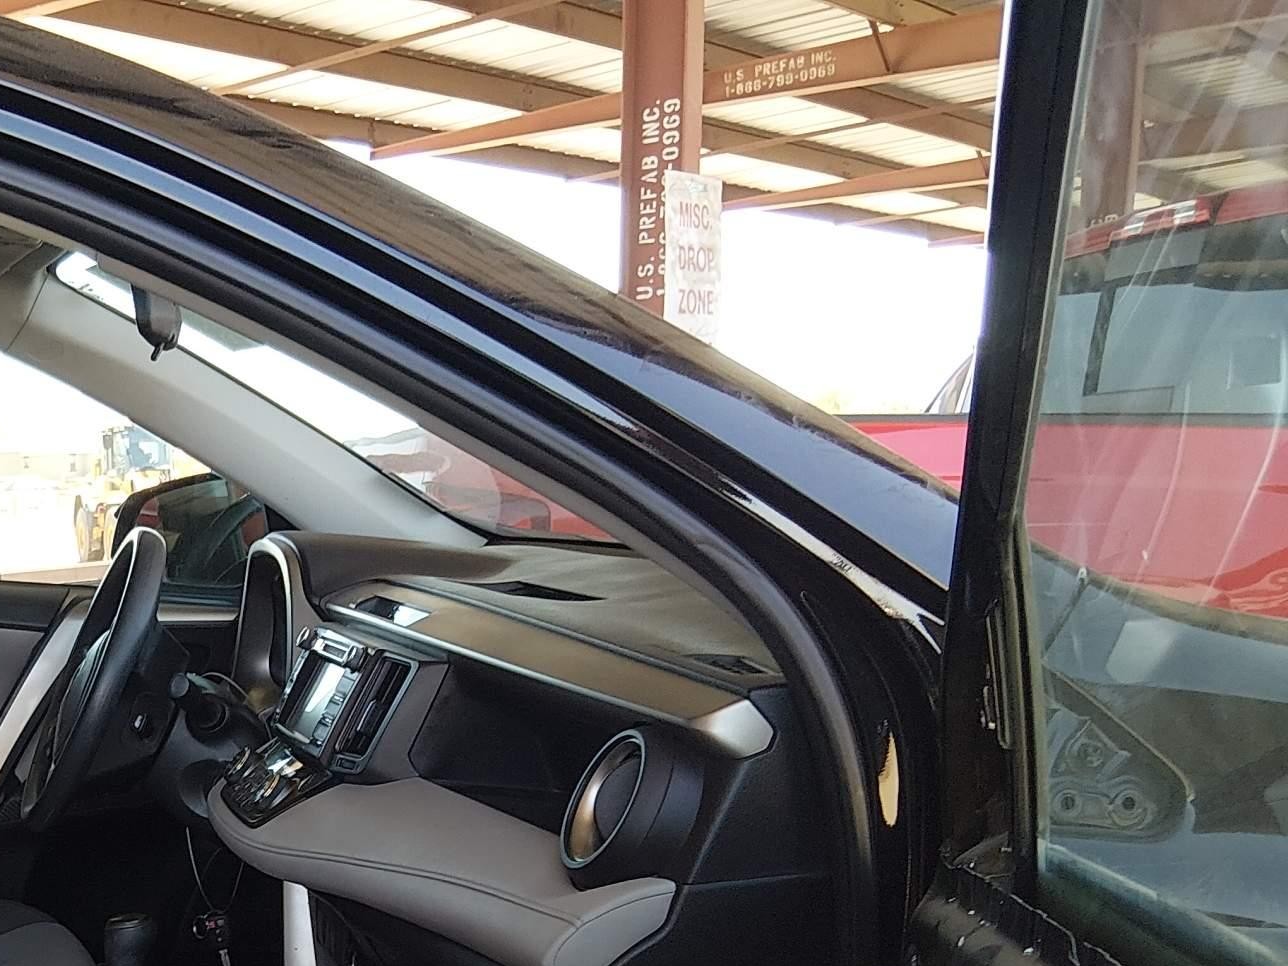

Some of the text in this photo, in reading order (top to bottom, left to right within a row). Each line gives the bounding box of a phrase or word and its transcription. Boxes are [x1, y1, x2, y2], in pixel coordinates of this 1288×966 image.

[754, 55, 805, 77] PREFAB
[811, 50, 837, 65] INC.
[636, 99, 661, 300] U.S. PREFAB INC.
[678, 245, 714, 272] DROP
[678, 288, 714, 315] ZONE
